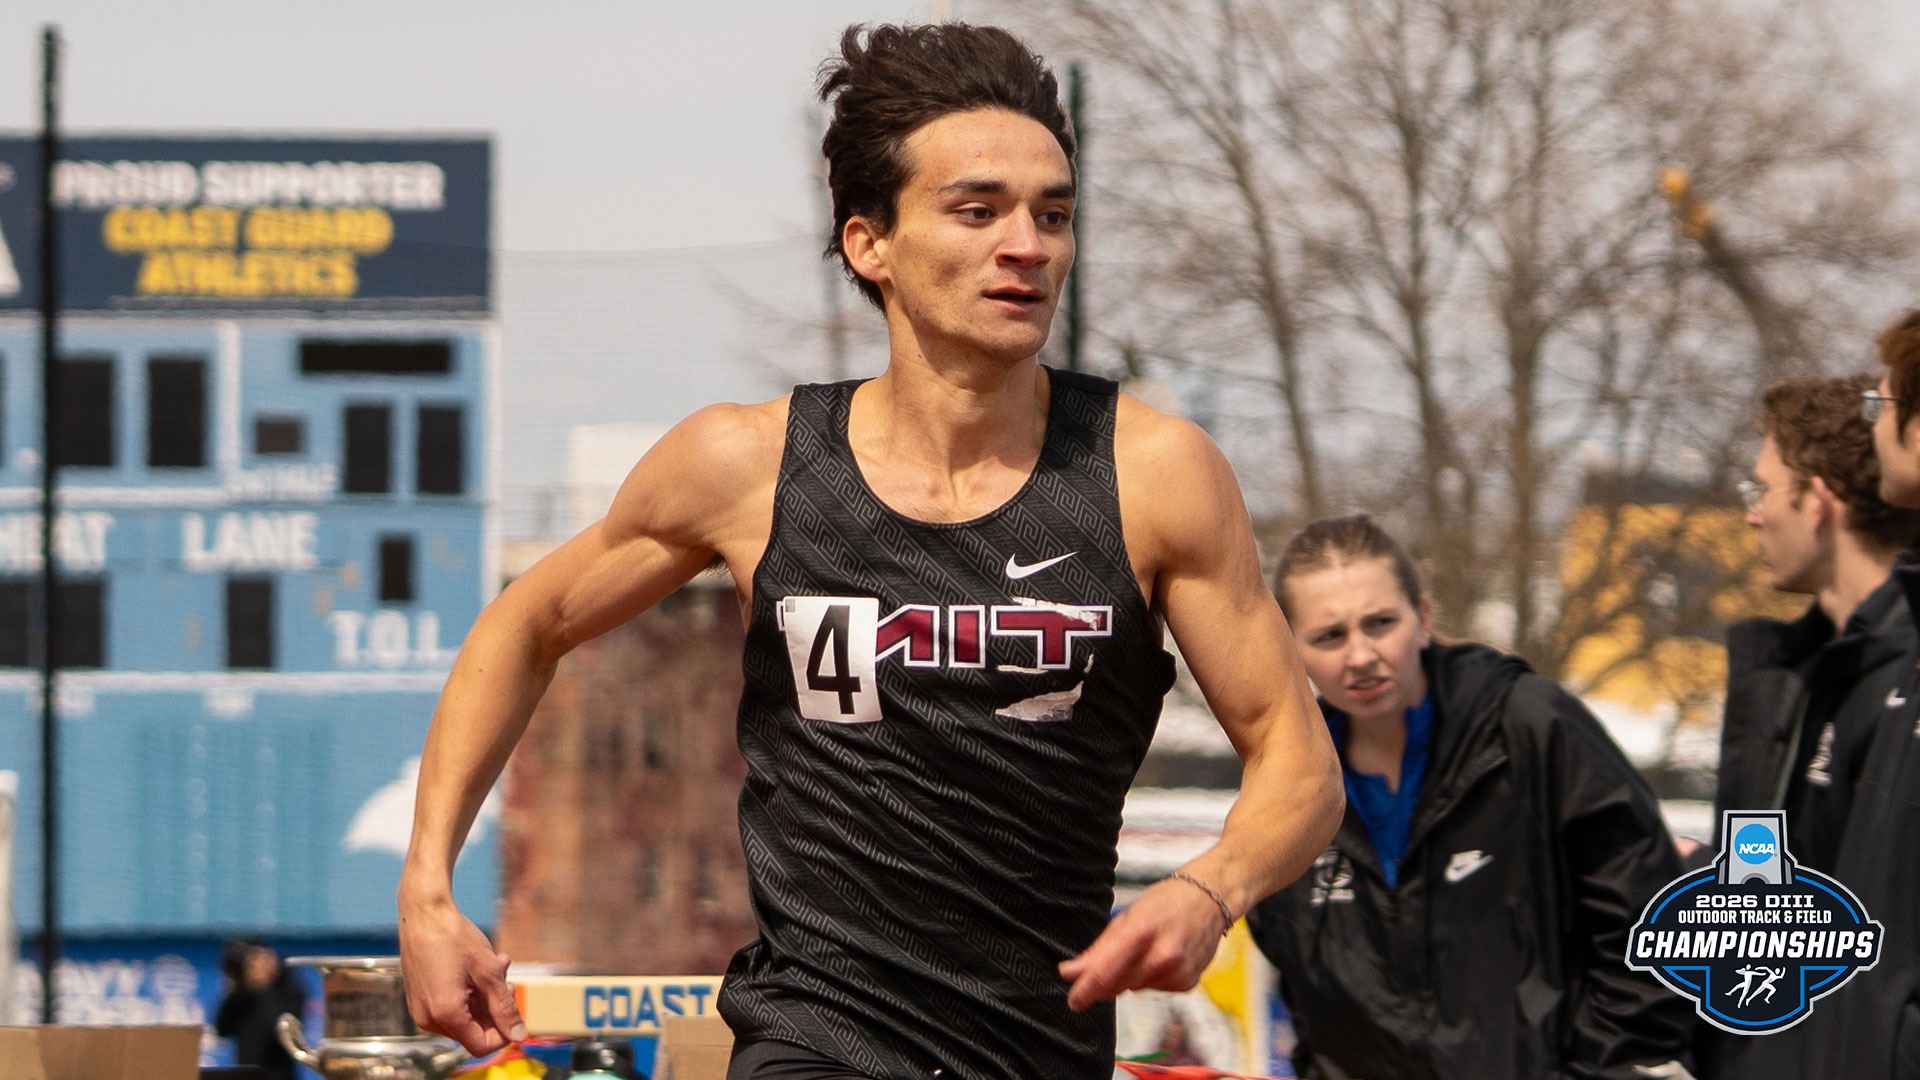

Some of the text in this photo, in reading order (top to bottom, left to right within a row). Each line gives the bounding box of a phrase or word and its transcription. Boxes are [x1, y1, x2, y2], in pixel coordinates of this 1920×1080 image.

[54, 159, 199, 207] PROUD
[202, 160, 446, 210] SUPPORTER
[104, 207, 395, 256] COAST GUARD
[137, 252, 360, 297] ATHLETICS
[182, 511, 319, 570] LANE
[806, 604, 862, 715] 4
[584, 985, 712, 1029] COAST
